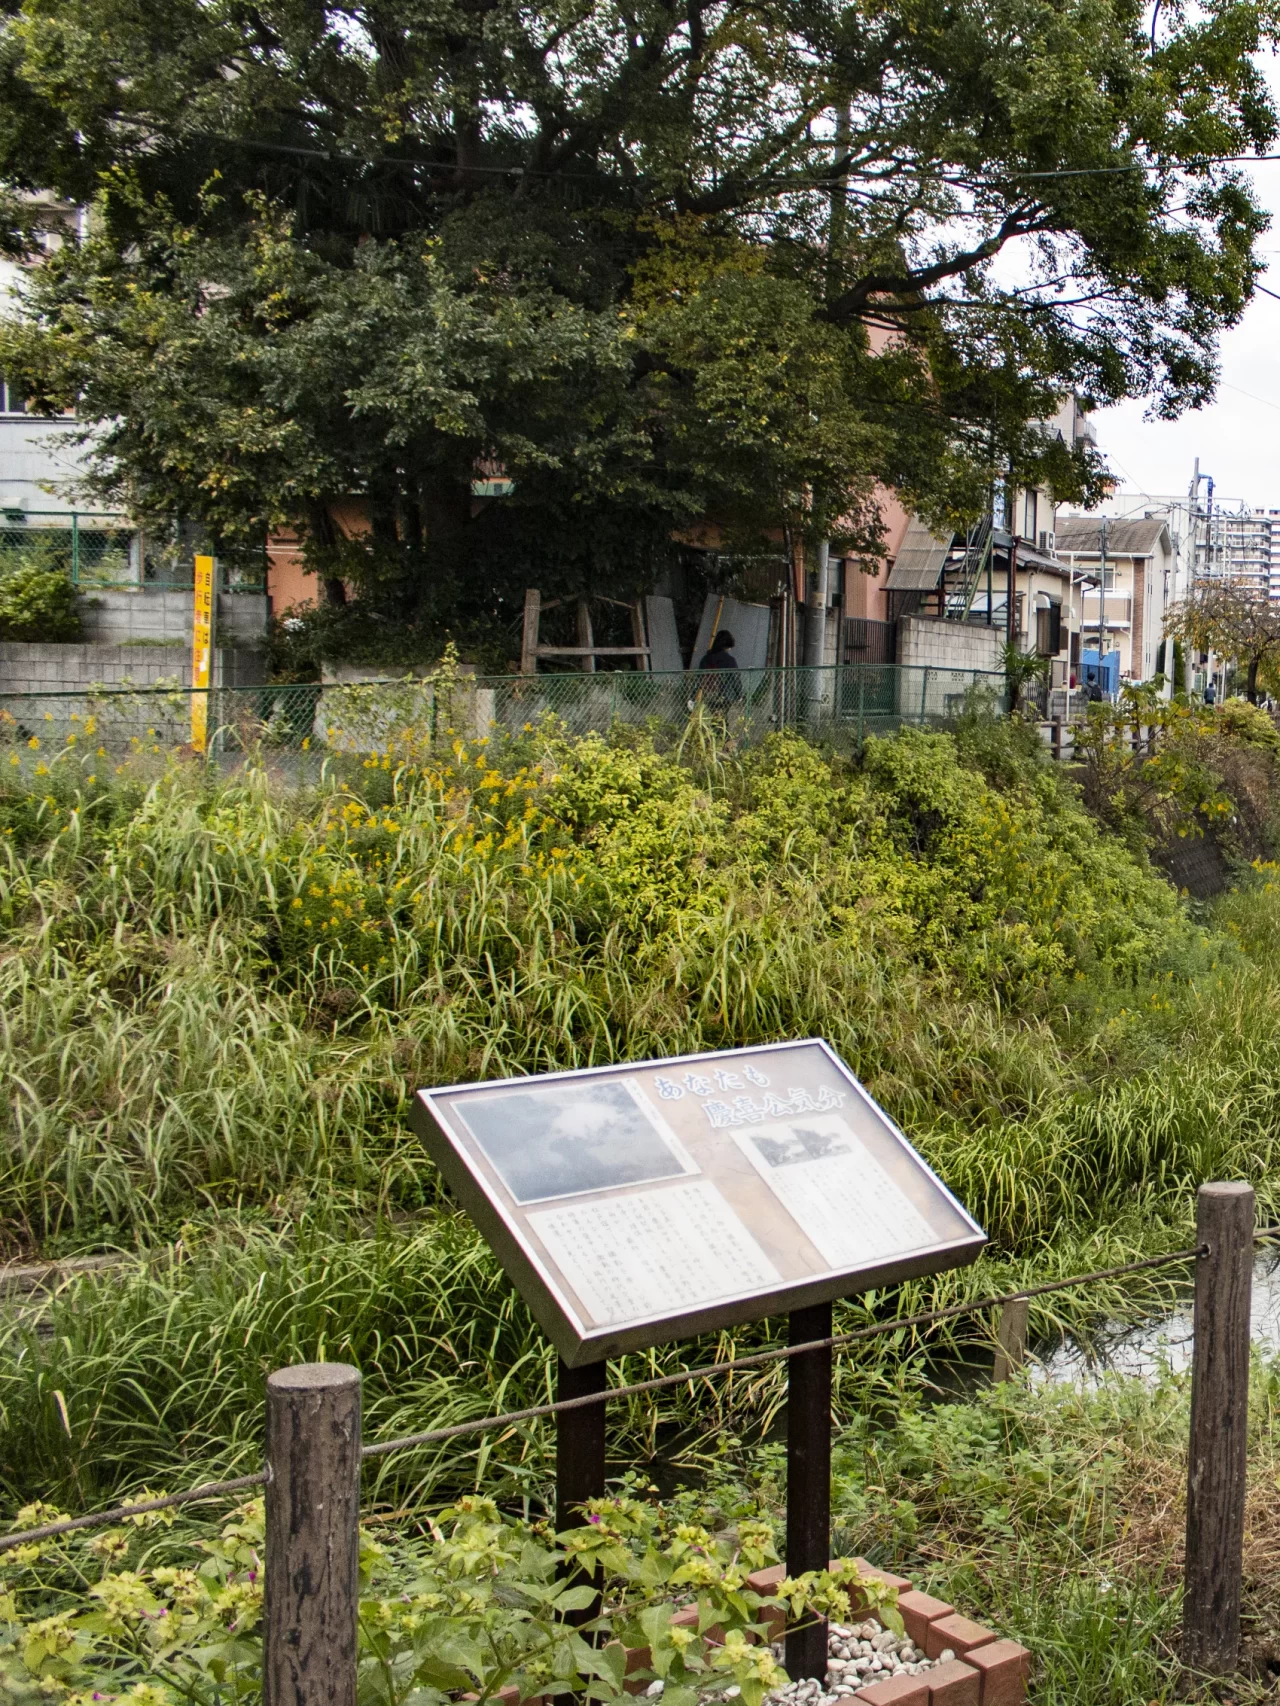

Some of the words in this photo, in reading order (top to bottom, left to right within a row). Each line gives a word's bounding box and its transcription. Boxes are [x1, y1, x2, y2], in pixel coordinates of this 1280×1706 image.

[655, 1065, 770, 1099] あなたも
[702, 1085, 845, 1127] 慶喜公気分
